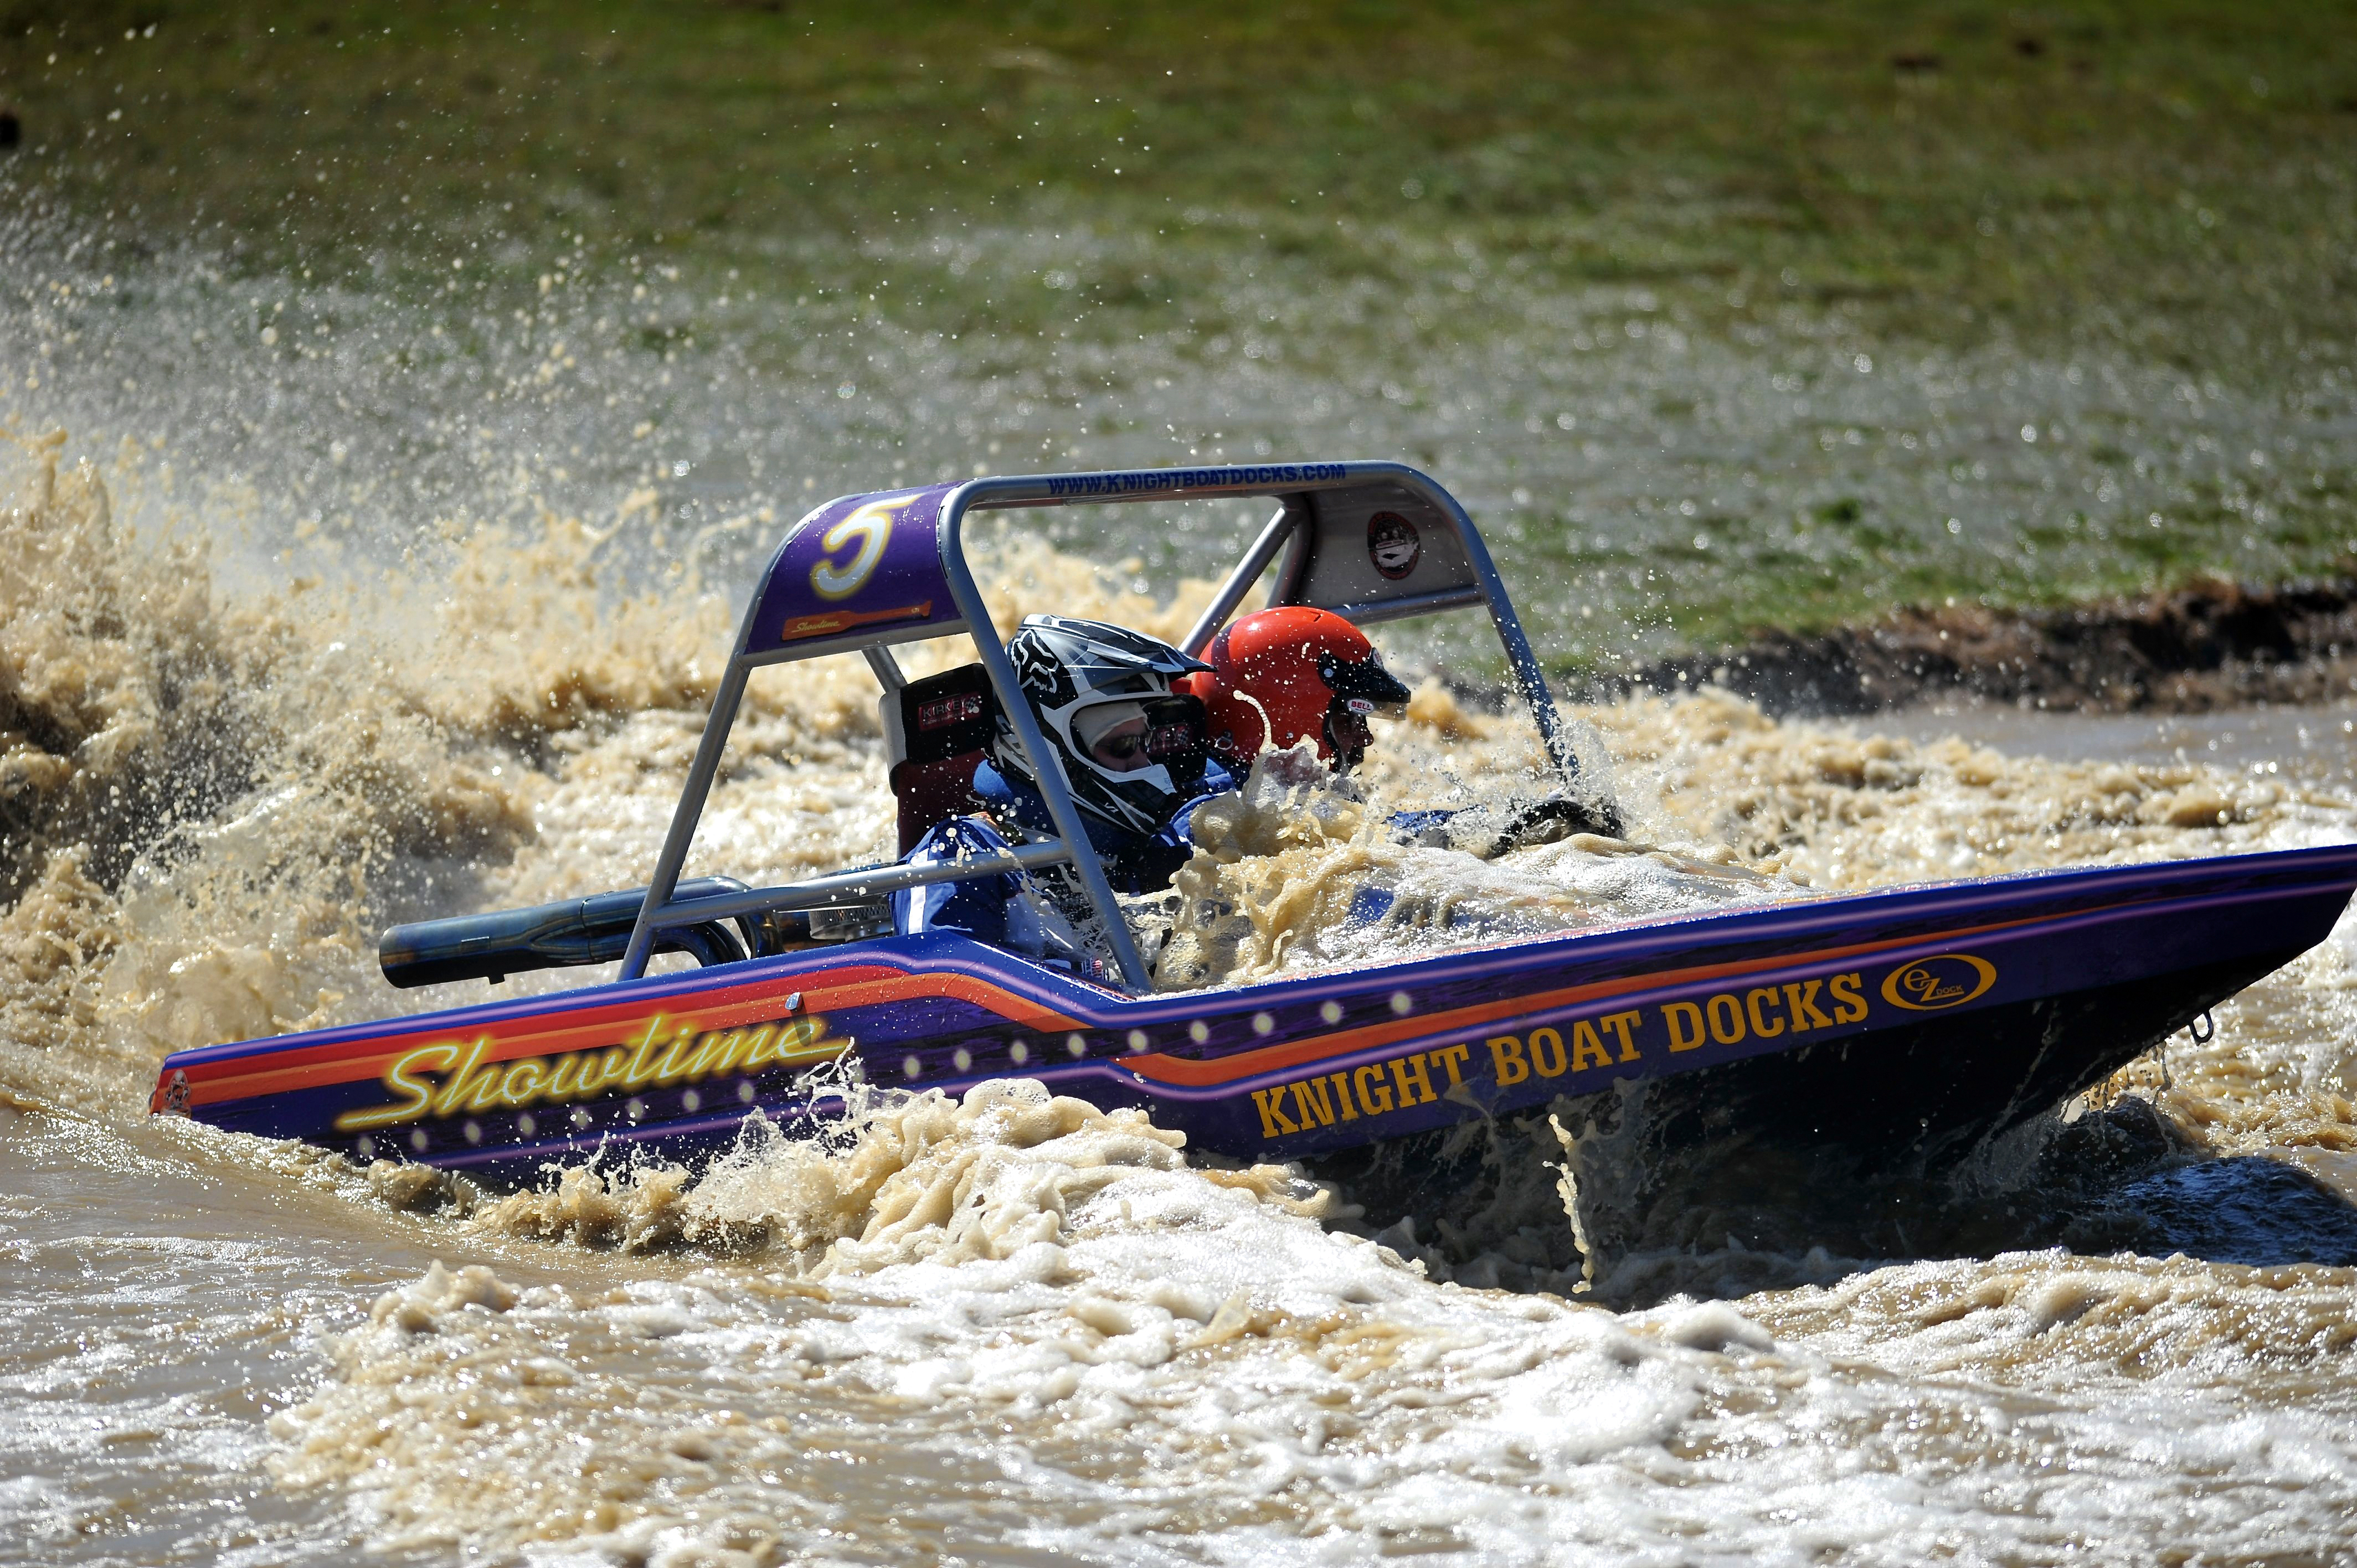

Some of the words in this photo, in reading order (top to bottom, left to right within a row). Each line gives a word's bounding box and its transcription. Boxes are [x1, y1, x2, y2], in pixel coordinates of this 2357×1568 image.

[1047, 464, 1346, 494] WWW.KNIGHTBOATDOCKS.COM
[811, 492, 926, 598] 5
[791, 619, 841, 633] Showtime
[923, 698, 966, 718] KIRKEY
[1351, 701, 1371, 710] BELL
[1936, 984, 1963, 996] DOCK
[1251, 1044, 1469, 1139] KNIGHT
[1486, 1010, 1642, 1087] BOAT
[1660, 973, 1869, 1053] DOCKS
[343, 1015, 848, 1125] Showtime
